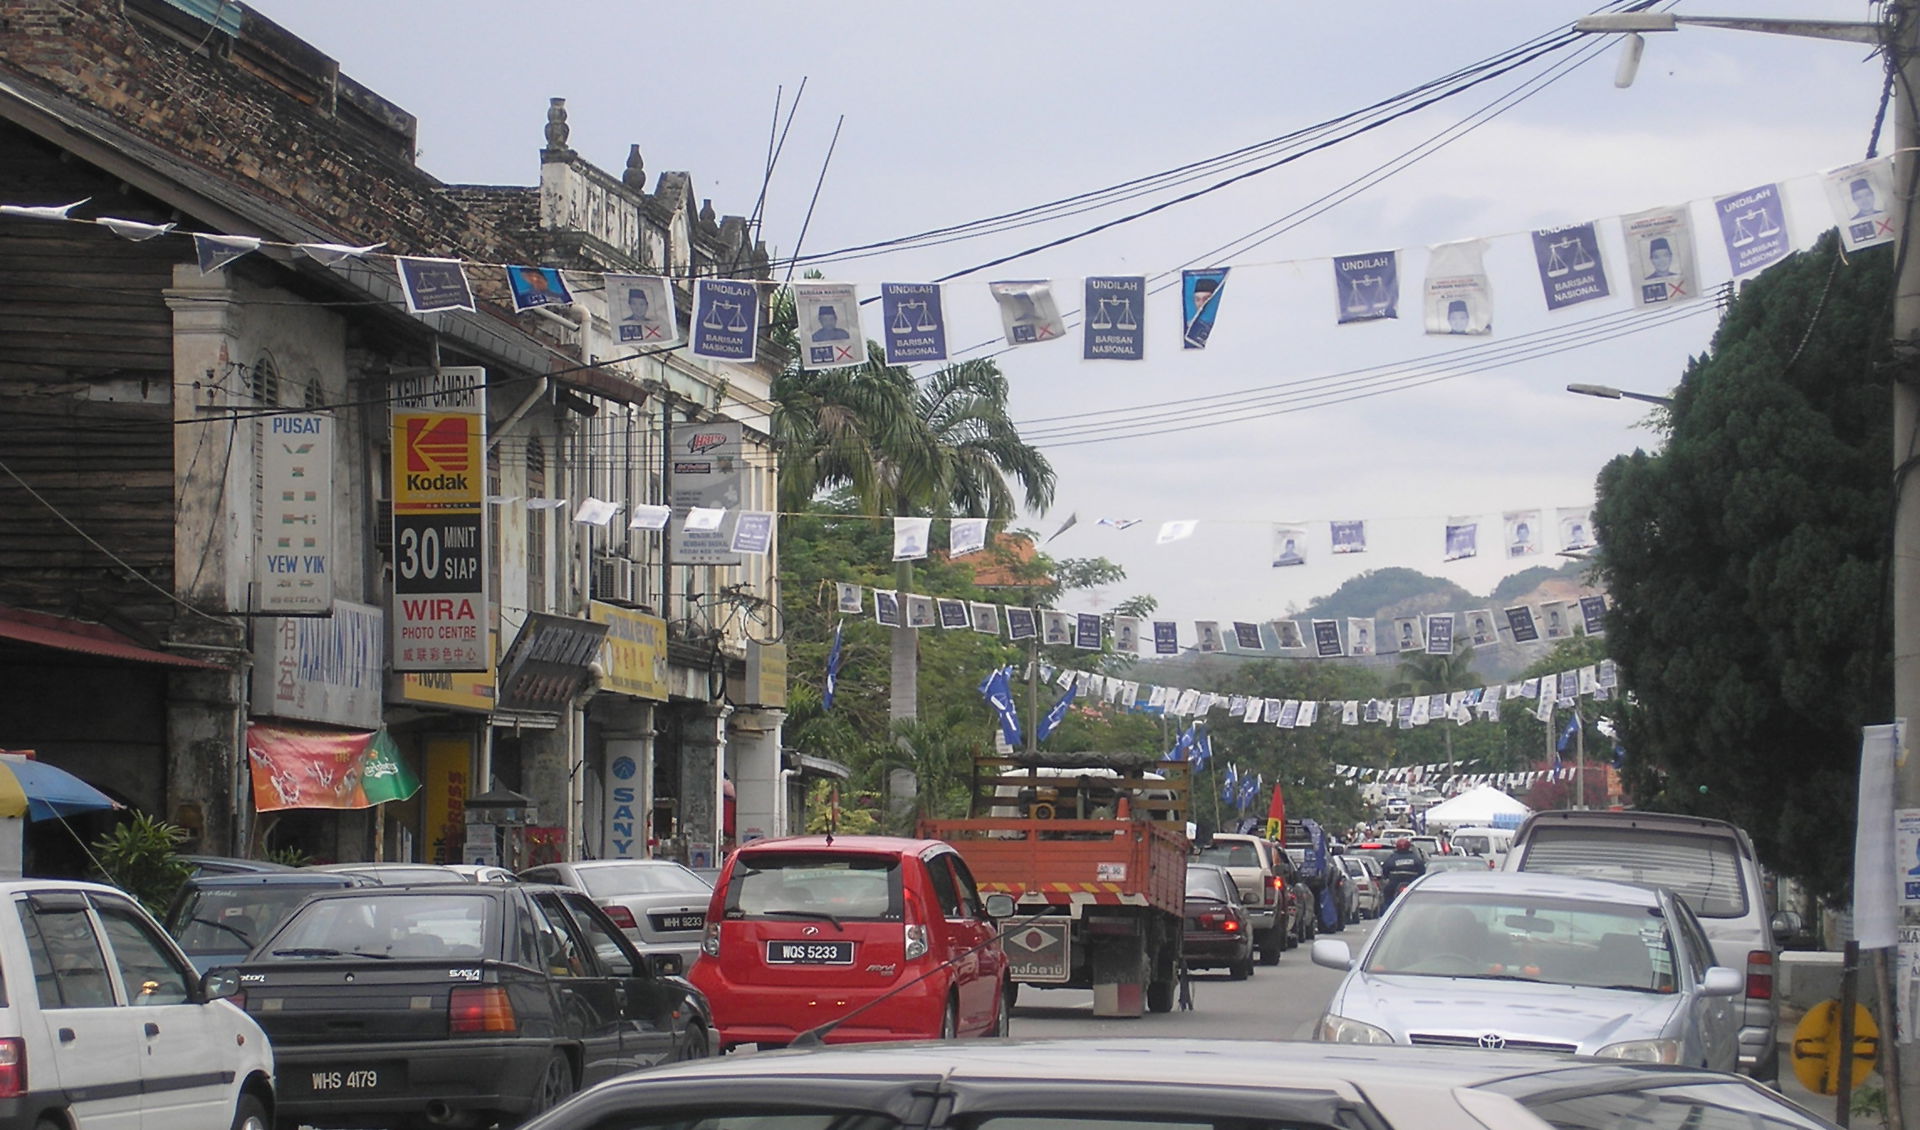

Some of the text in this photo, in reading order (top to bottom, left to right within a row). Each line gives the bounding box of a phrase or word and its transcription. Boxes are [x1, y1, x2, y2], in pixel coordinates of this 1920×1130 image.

[1723, 189, 1771, 213] UNDILAH
[1740, 239, 1779, 258] BARISAN
[1342, 257, 1388, 271] UNDILAH
[706, 282, 750, 297] UNDILAH
[888, 285, 933, 295] UNDILAH
[1092, 280, 1138, 291] UNDILAH
[1554, 275, 1595, 291] BARISAN
[1554, 286, 1600, 302] NASIONAL
[705, 334, 743, 345] BARISAN
[896, 337, 935, 347] BARISAN
[1095, 335, 1133, 344] BARISAN
[702, 343, 745, 354] NASIONAL
[894, 346, 938, 356] NASIONAL
[1092, 345, 1136, 354] NASIONAL
[433, 375, 476, 407] GAMBAR
[273, 417, 322, 434] PUSAT
[407, 474, 468, 490] Kodak
[400, 526, 476, 580] 30 MINIT
[267, 555, 325, 573] YEW YIK
[445, 557, 477, 580] SIAP
[402, 598, 475, 621] WIRA
[402, 626, 476, 639] PHOTO CENTRE
[612, 788, 635, 860] SANY
[783, 945, 838, 959] WQS 5233
[449, 969, 480, 977] SAGA
[312, 1070, 377, 1090] WHS 4179
